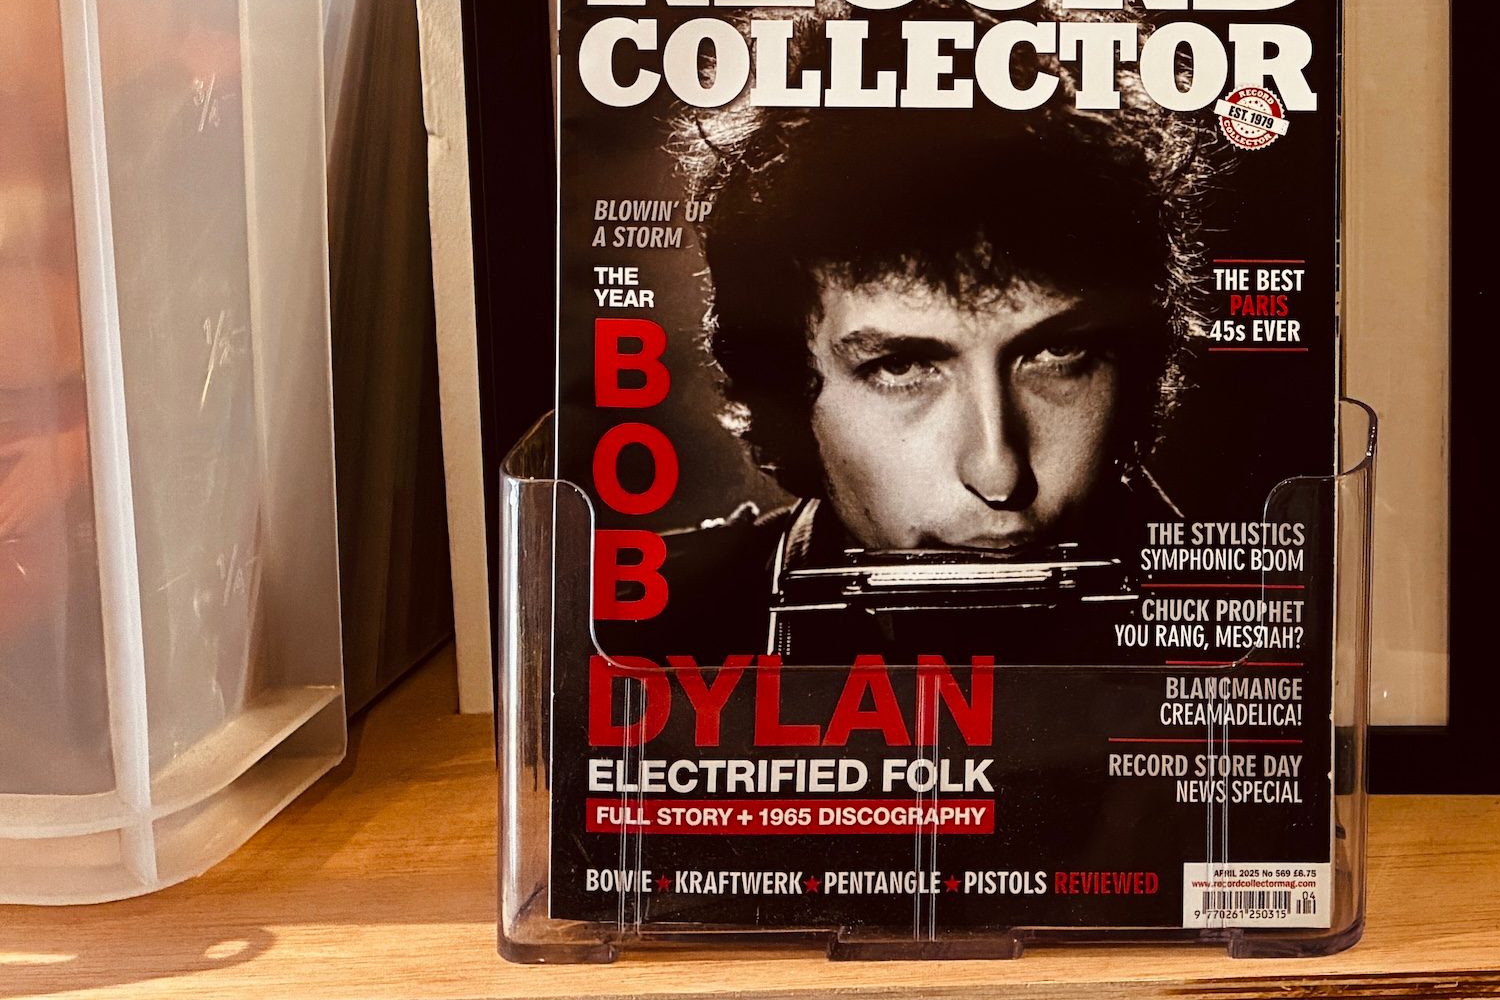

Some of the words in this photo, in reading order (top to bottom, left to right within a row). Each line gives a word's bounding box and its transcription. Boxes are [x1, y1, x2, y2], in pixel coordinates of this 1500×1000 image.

[578, 17, 1317, 111] COLLECTOR
[1239, 89, 1274, 105] RECORD
[1228, 105, 1248, 122] EST.
[1250, 112, 1274, 129] 1979
[1223, 120, 1271, 146] COLLECTOR
[594, 200, 679, 222] BLOWIN'
[684, 201, 712, 222] UP
[592, 226, 606, 247] A
[613, 226, 682, 248] STORM
[594, 267, 639, 285] THE
[1213, 268, 1249, 291] THE
[1256, 269, 1305, 292] BEST
[594, 288, 655, 308] YEAR
[1230, 295, 1289, 317] PARIS
[1209, 320, 1246, 342] 45s
[1252, 320, 1301, 342] EVER
[1147, 522, 1184, 545] THE
[1191, 522, 1305, 546] STYLISTICS
[1140, 548, 1246, 571] SYMPHONIC
[1250, 549, 1304, 571] BOOM
[1141, 599, 1210, 622] CHUCK
[1216, 600, 1305, 623] PROPHET
[1115, 624, 1149, 647] YOU
[1155, 624, 1209, 650] RANG,
[1215, 625, 1304, 649] MESSIAH?
[1165, 676, 1303, 700] BLANCMANGE
[588, 655, 995, 747] DYLAN
[1160, 702, 1303, 726] CREAMADELICA!
[588, 759, 868, 793] ELECTRIFIED
[882, 759, 995, 793] FOLK
[1109, 753, 1188, 776] RECORD
[1194, 754, 1257, 777] STORE
[1263, 755, 1303, 777] DAY
[1176, 780, 1226, 803] NEWS
[1231, 780, 1303, 804] SPECIAL
[596, 807, 651, 825] FULL
[657, 807, 734, 826] STORY
[737, 809, 753, 825] +
[759, 807, 811, 826] 1965
[819, 807, 987, 827] DISCOGRAPHY
[586, 868, 653, 893] BOWIE
[675, 870, 803, 895] KRAFTWERK
[824, 871, 941, 895] PENTANGLE
[964, 871, 1047, 895] PISTOLS
[1055, 872, 1159, 895] REVIEWED
[1191, 880, 1317, 889] www.recordcollectormag.com
[1213, 869, 1237, 877] APRIL
[1239, 869, 1260, 877] 2025
[1262, 869, 1273, 877] No
[1302, 891, 1316, 900] 04
[1194, 910, 1201, 919] 9
[1249, 910, 1287, 919] 250315
